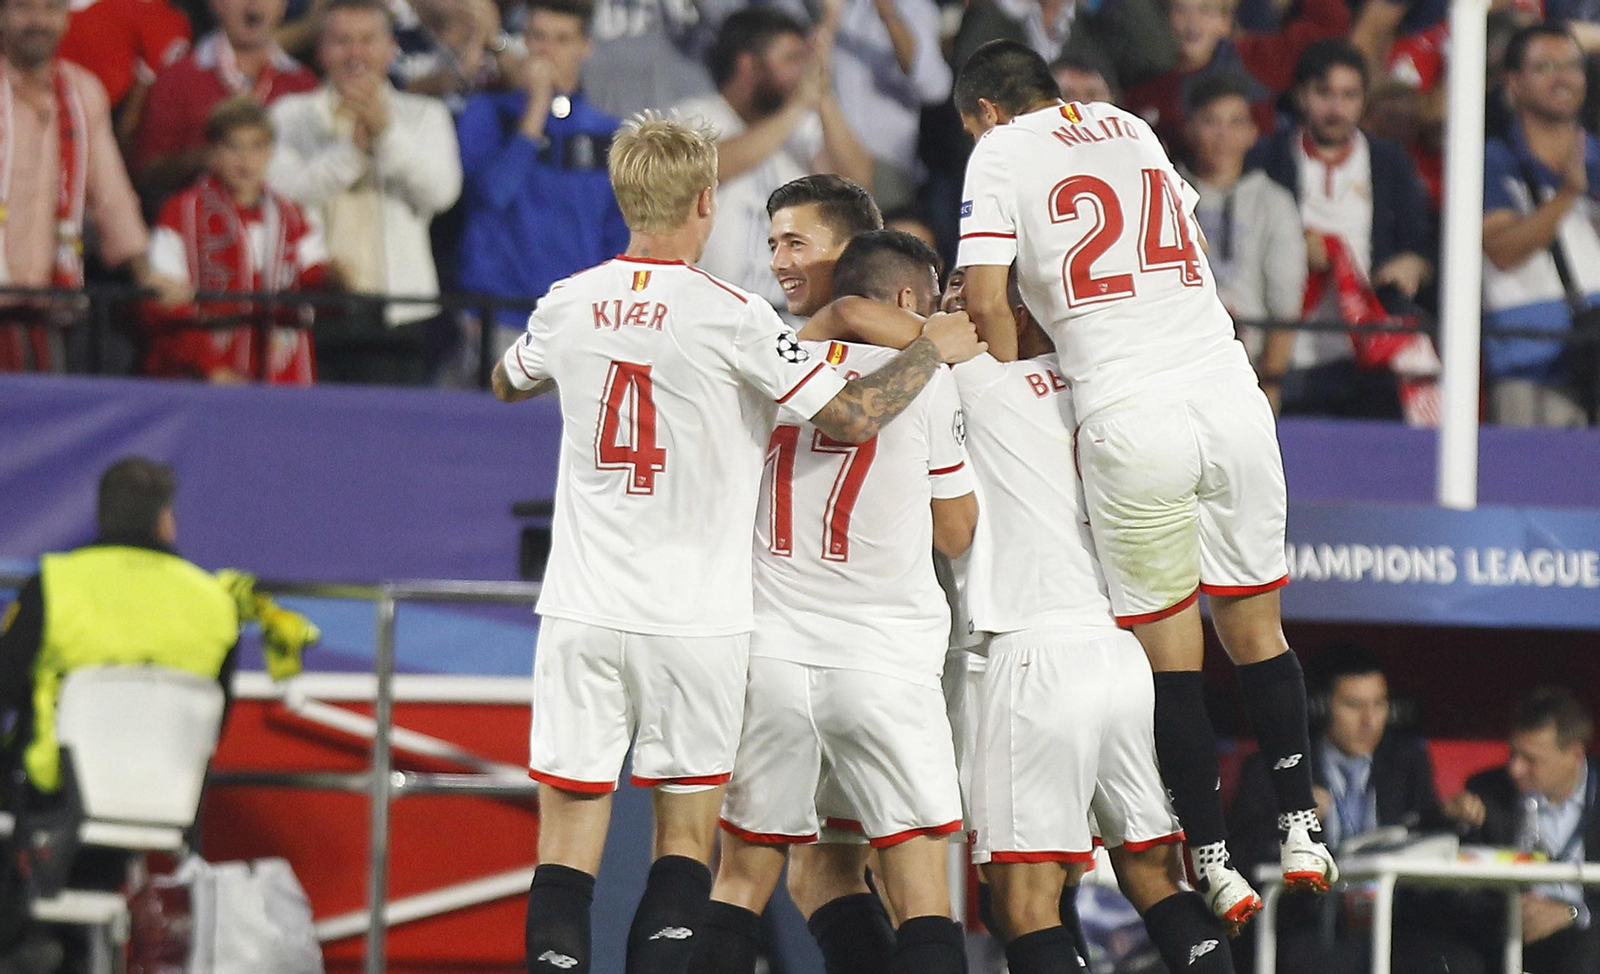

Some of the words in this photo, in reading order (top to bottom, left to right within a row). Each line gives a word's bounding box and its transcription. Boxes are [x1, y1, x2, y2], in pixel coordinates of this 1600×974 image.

[1052, 115, 1140, 147] NOLITO
[1048, 168, 1204, 309] 24
[591, 299, 669, 332] KJÆR
[593, 360, 668, 496] 4
[764, 424, 879, 564] 17
[1464, 547, 1599, 588] LEAGUE
